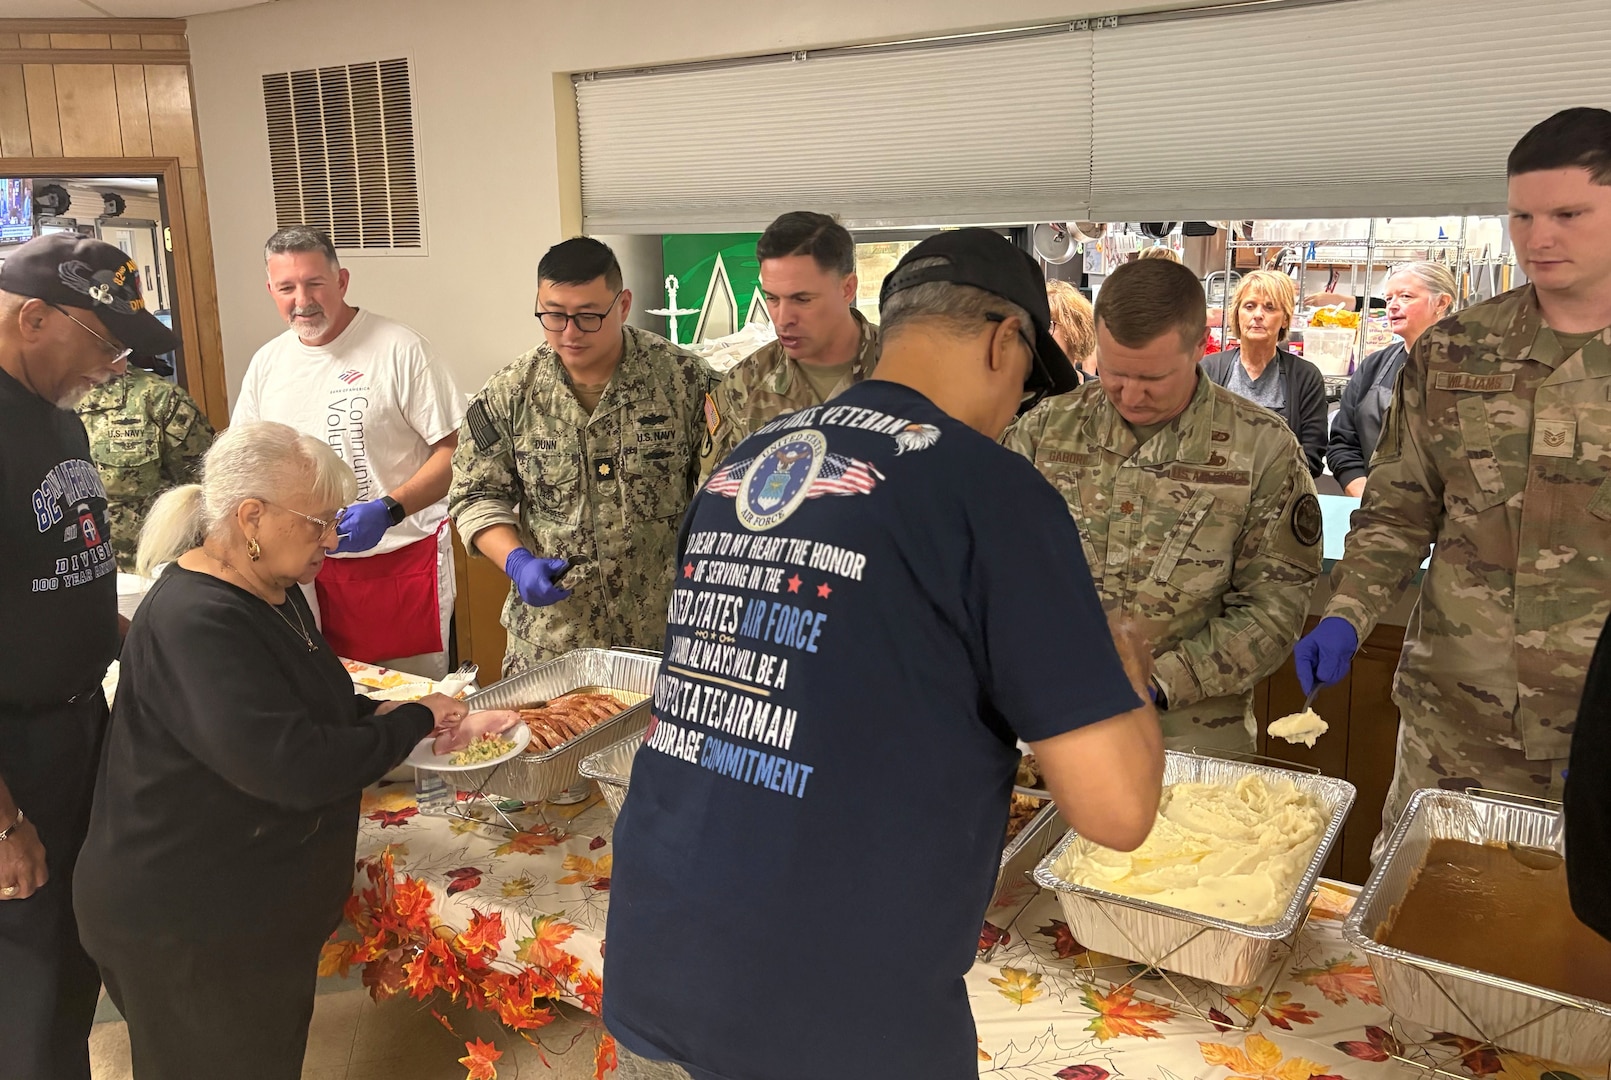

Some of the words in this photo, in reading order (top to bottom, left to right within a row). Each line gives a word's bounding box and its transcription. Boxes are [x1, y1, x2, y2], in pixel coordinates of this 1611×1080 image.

[1448, 374, 1502, 390] WILLIAMS
[107, 430, 122, 438] U.S.
[327, 398, 347, 459] Volun
[636, 432, 652, 443] U.S.
[653, 430, 676, 441] NAVY
[819, 405, 912, 435] VETERAN
[350, 396, 370, 502] Community
[535, 440, 557, 450] DUNN
[762, 433, 803, 458] UNITED
[741, 508, 753, 523] AIR
[753, 509, 785, 527] FORCE
[56, 539, 113, 575] DIVISI
[690, 531, 718, 555] DEAR
[715, 532, 732, 555] TO
[729, 533, 752, 557] MY
[748, 536, 787, 562] HEART
[784, 539, 811, 566] THE
[809, 542, 866, 581] HONOR
[32, 577, 59, 592] 100
[63, 568, 94, 588] YEAR
[694, 560, 708, 583] OF
[706, 560, 750, 588] SERVING
[748, 566, 764, 591] IN
[762, 567, 785, 593] THE
[688, 591, 743, 634] STATES
[740, 598, 767, 640] AIR
[764, 603, 827, 653] FORCE
[688, 639, 736, 675] ALWAYS
[732, 648, 756, 681] WILL
[755, 654, 778, 685] BE
[777, 658, 788, 690] A
[722, 694, 798, 750] AIRMAN
[700, 735, 814, 799] COMMITMENT
